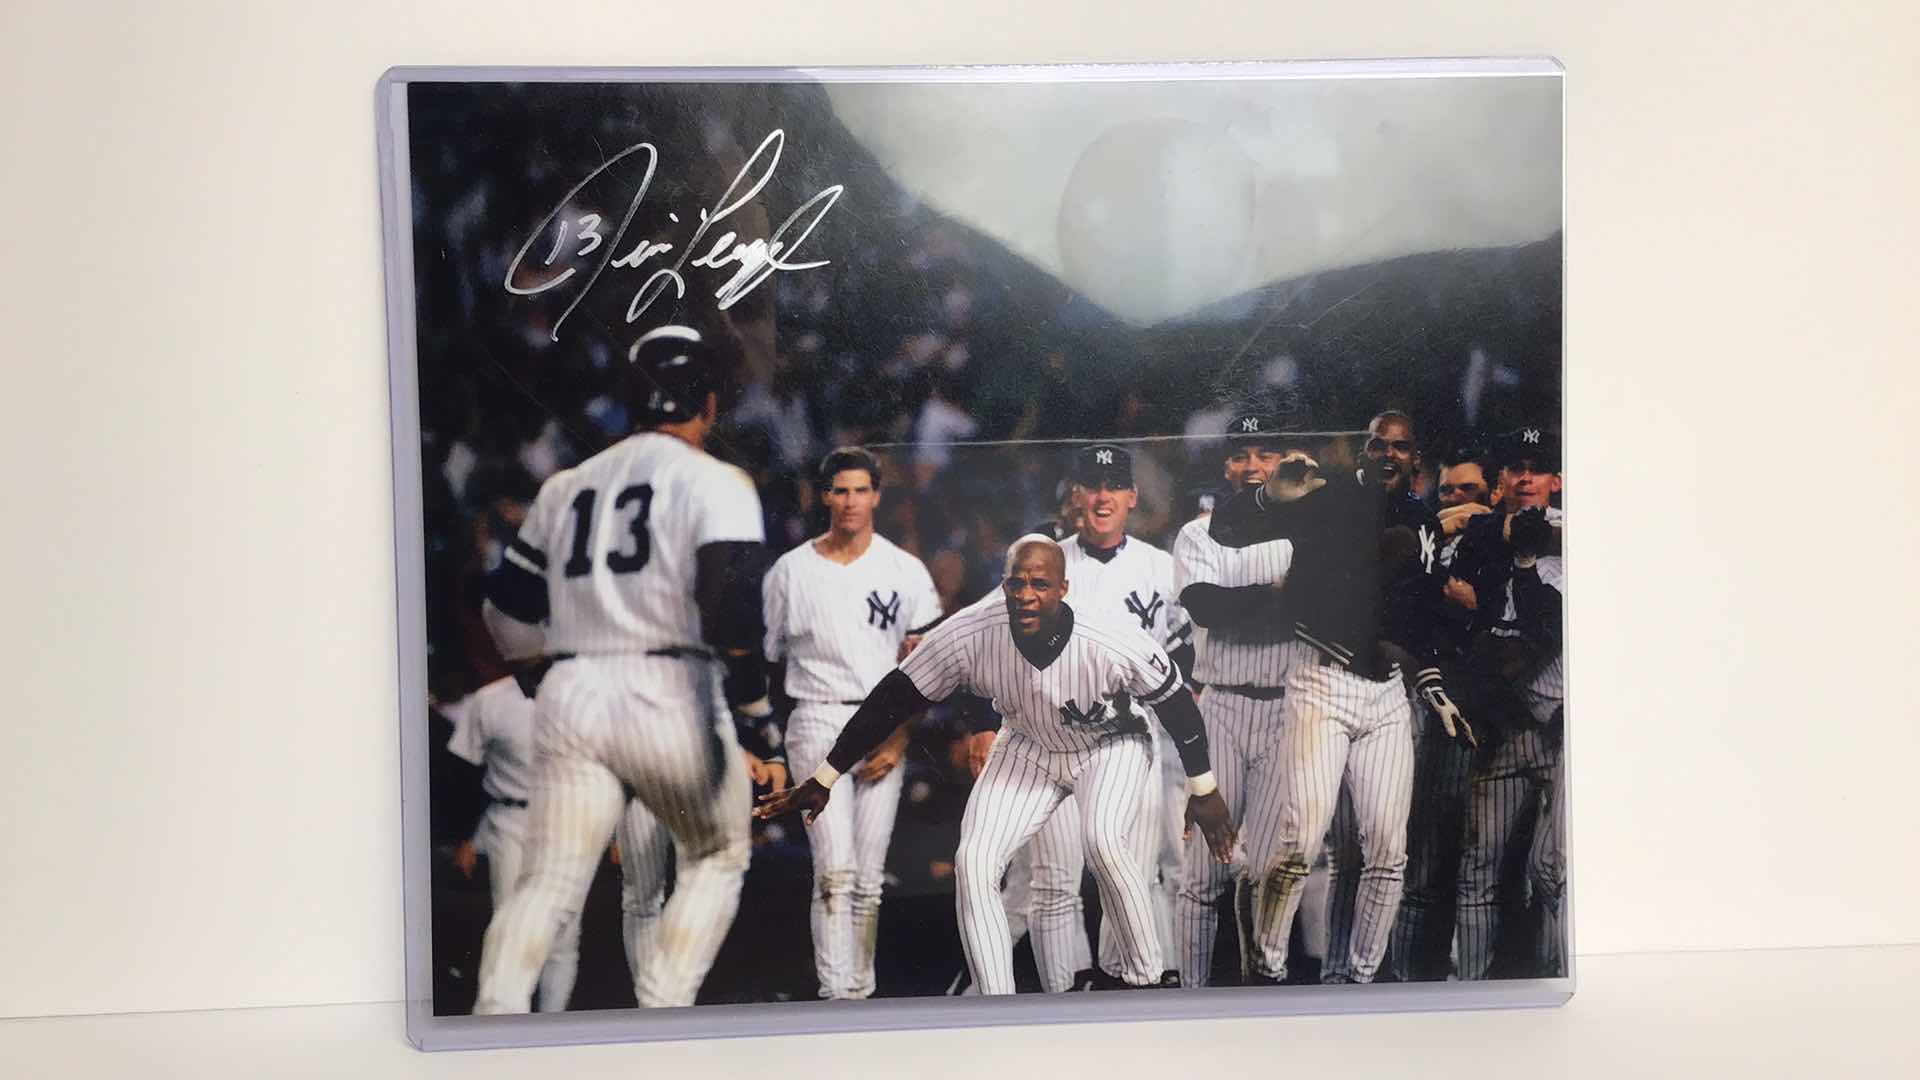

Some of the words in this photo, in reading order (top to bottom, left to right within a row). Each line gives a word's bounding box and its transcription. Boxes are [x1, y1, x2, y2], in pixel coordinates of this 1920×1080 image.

[544, 214, 602, 266] 13
[1242, 416, 1258, 432] NY
[1523, 428, 1540, 444] NY
[1096, 449, 1112, 465] NY
[564, 483, 655, 578] 13
[866, 589, 901, 630] NY
[1124, 590, 1165, 631] NY
